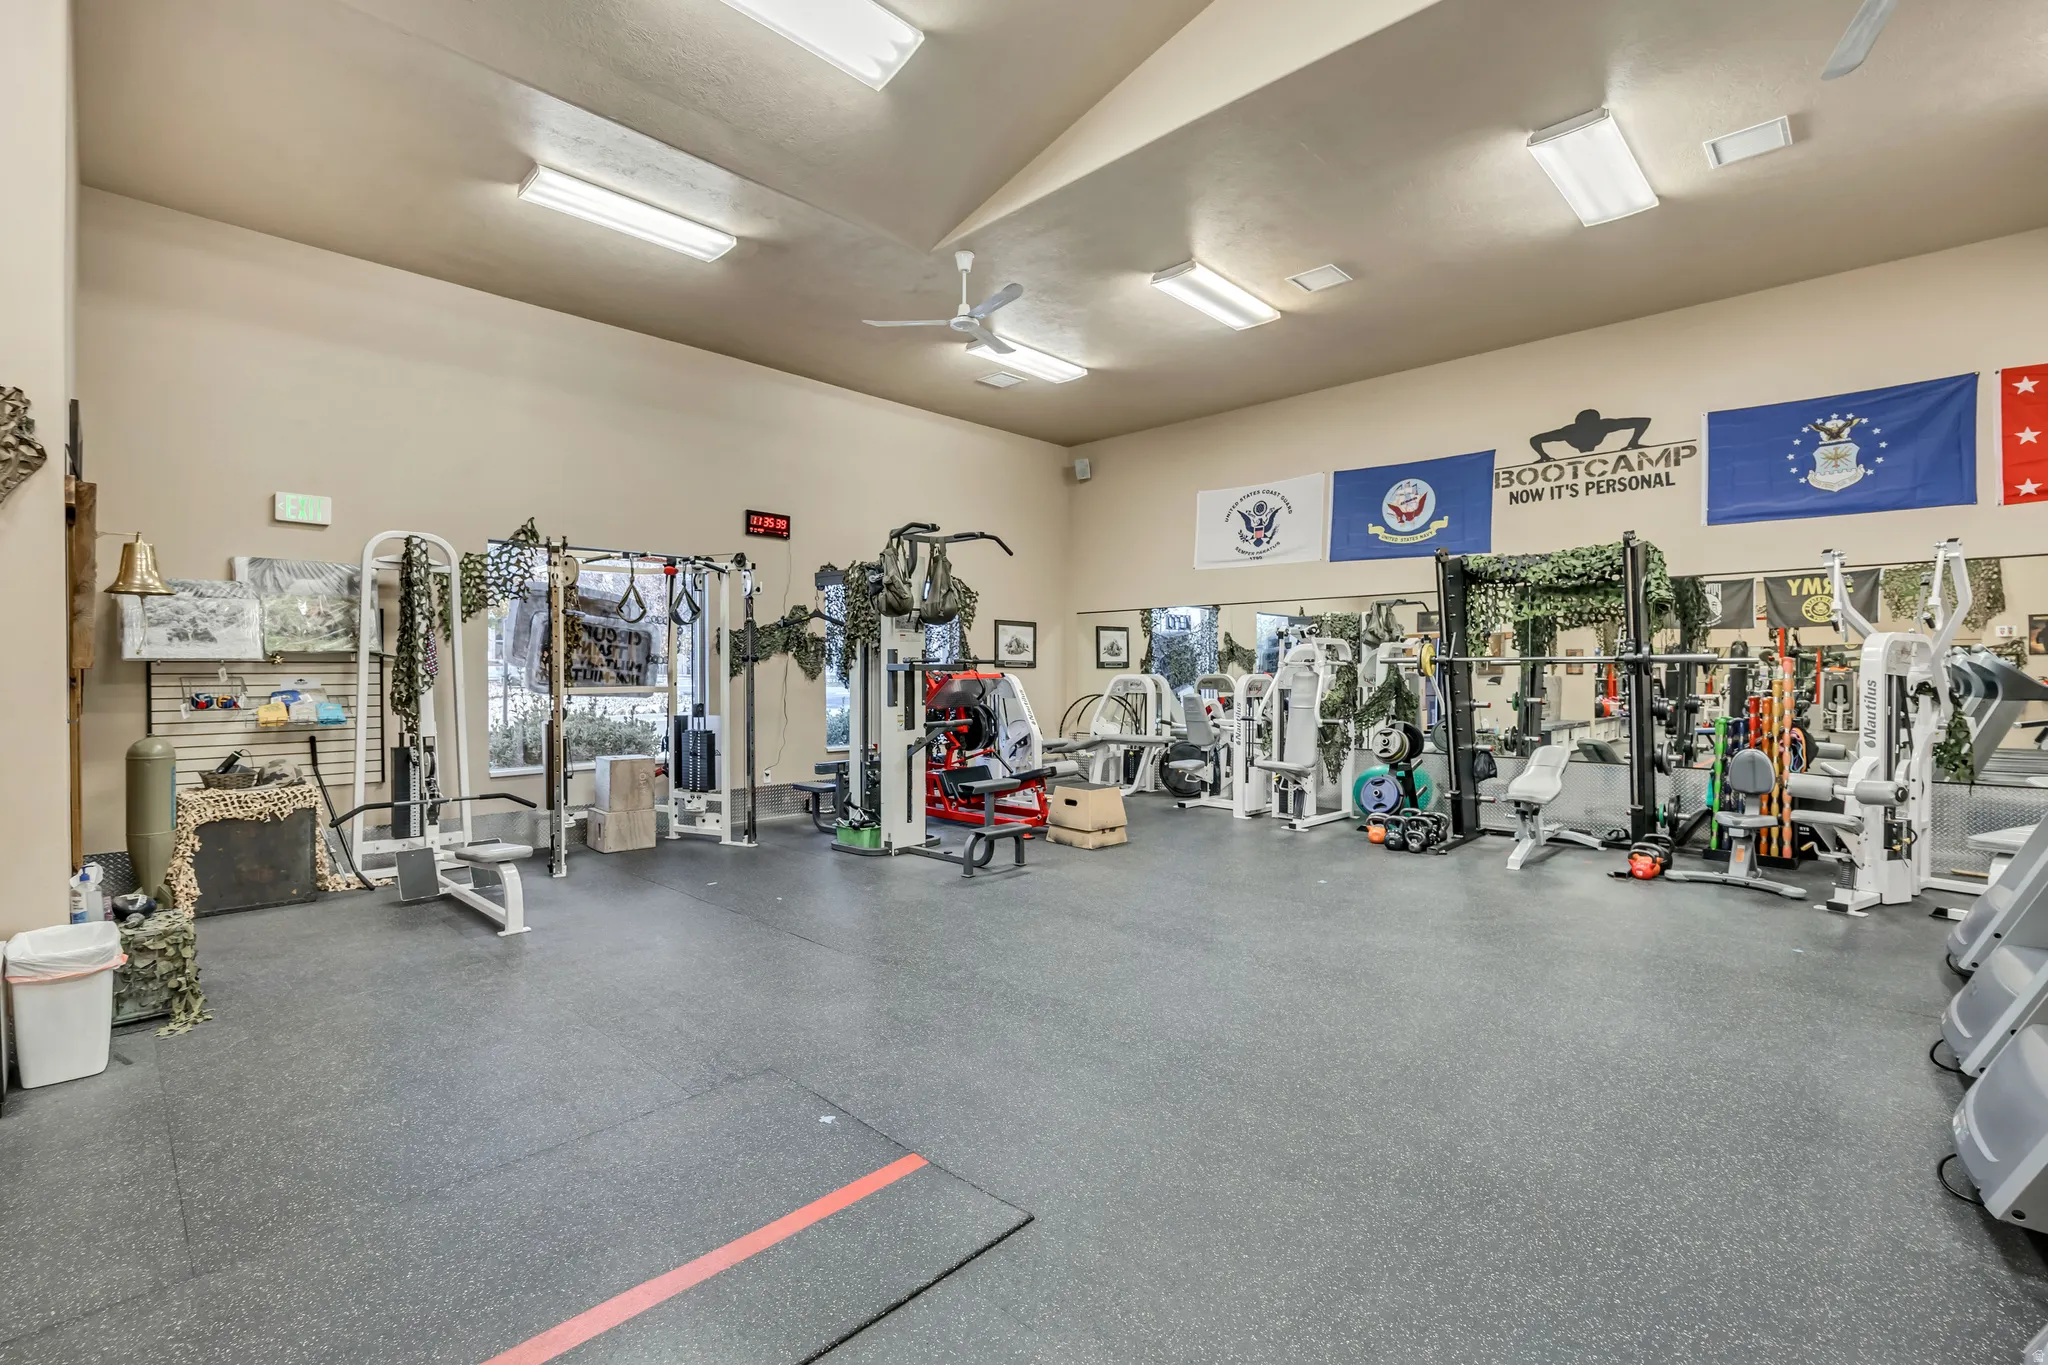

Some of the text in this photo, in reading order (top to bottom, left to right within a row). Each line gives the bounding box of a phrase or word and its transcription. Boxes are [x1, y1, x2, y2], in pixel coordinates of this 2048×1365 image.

[1494, 444, 1698, 490] BOOTCAMP
[1509, 471, 1676, 505] NOW IT'S PERSONAL
[285, 494, 326, 521] EXIT
[1224, 501, 1240, 523] UNITED
[1239, 489, 1261, 502] STATES
[1261, 489, 1281, 498] COAST
[1280, 495, 1293, 515] GUARD
[1234, 546, 1256, 556] SEMPER
[1381, 534, 1399, 542] UNITED
[1420, 531, 1434, 539] NAVY
[1019, 689, 1034, 722] Nautilus
[1864, 680, 1877, 740] Nautilus
